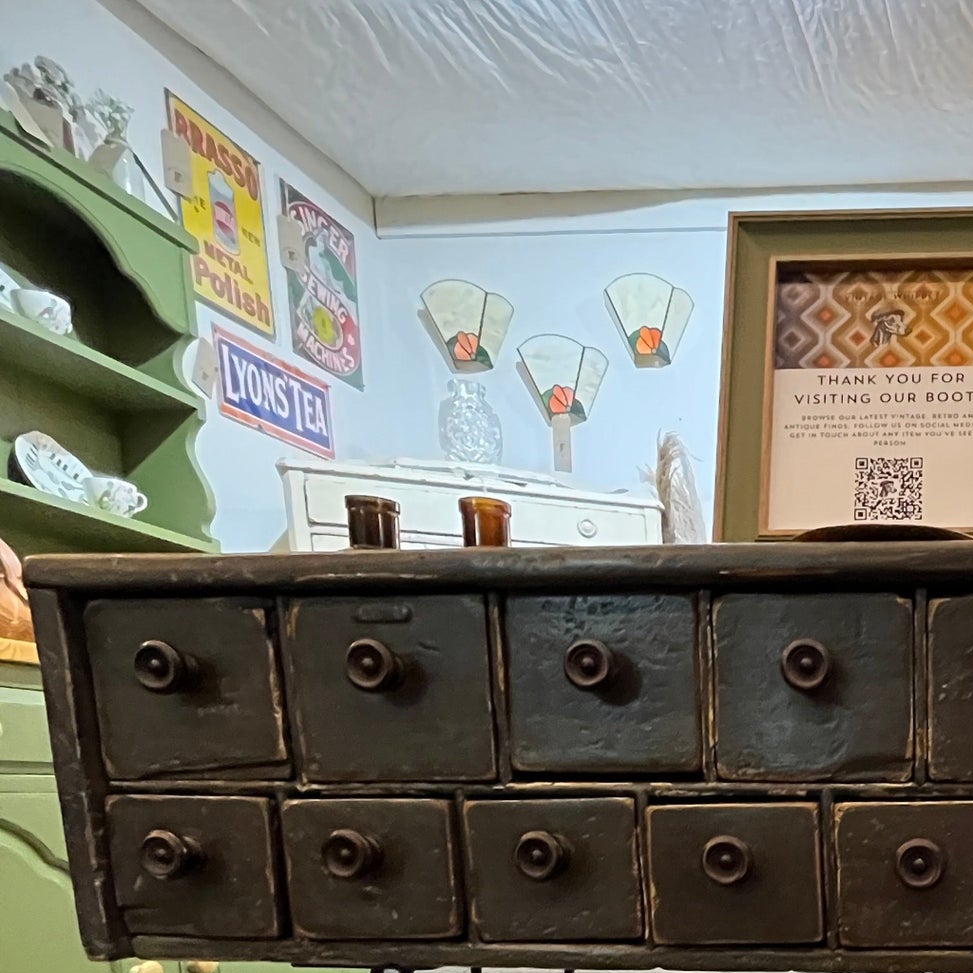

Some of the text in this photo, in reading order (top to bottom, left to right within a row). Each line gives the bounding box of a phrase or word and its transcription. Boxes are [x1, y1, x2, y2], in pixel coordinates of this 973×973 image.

[204, 239, 254, 285] METAL
[290, 205, 349, 265] SINGER
[195, 255, 271, 328] Polish
[300, 264, 348, 325] SEWING
[296, 322, 355, 373] MACHINES
[221, 343, 329, 437] LYONS' TEA
[794, 393, 872, 405] VISITING
[879, 392, 917, 404] OUR
[817, 372, 966, 386] THANK YOU FOR
